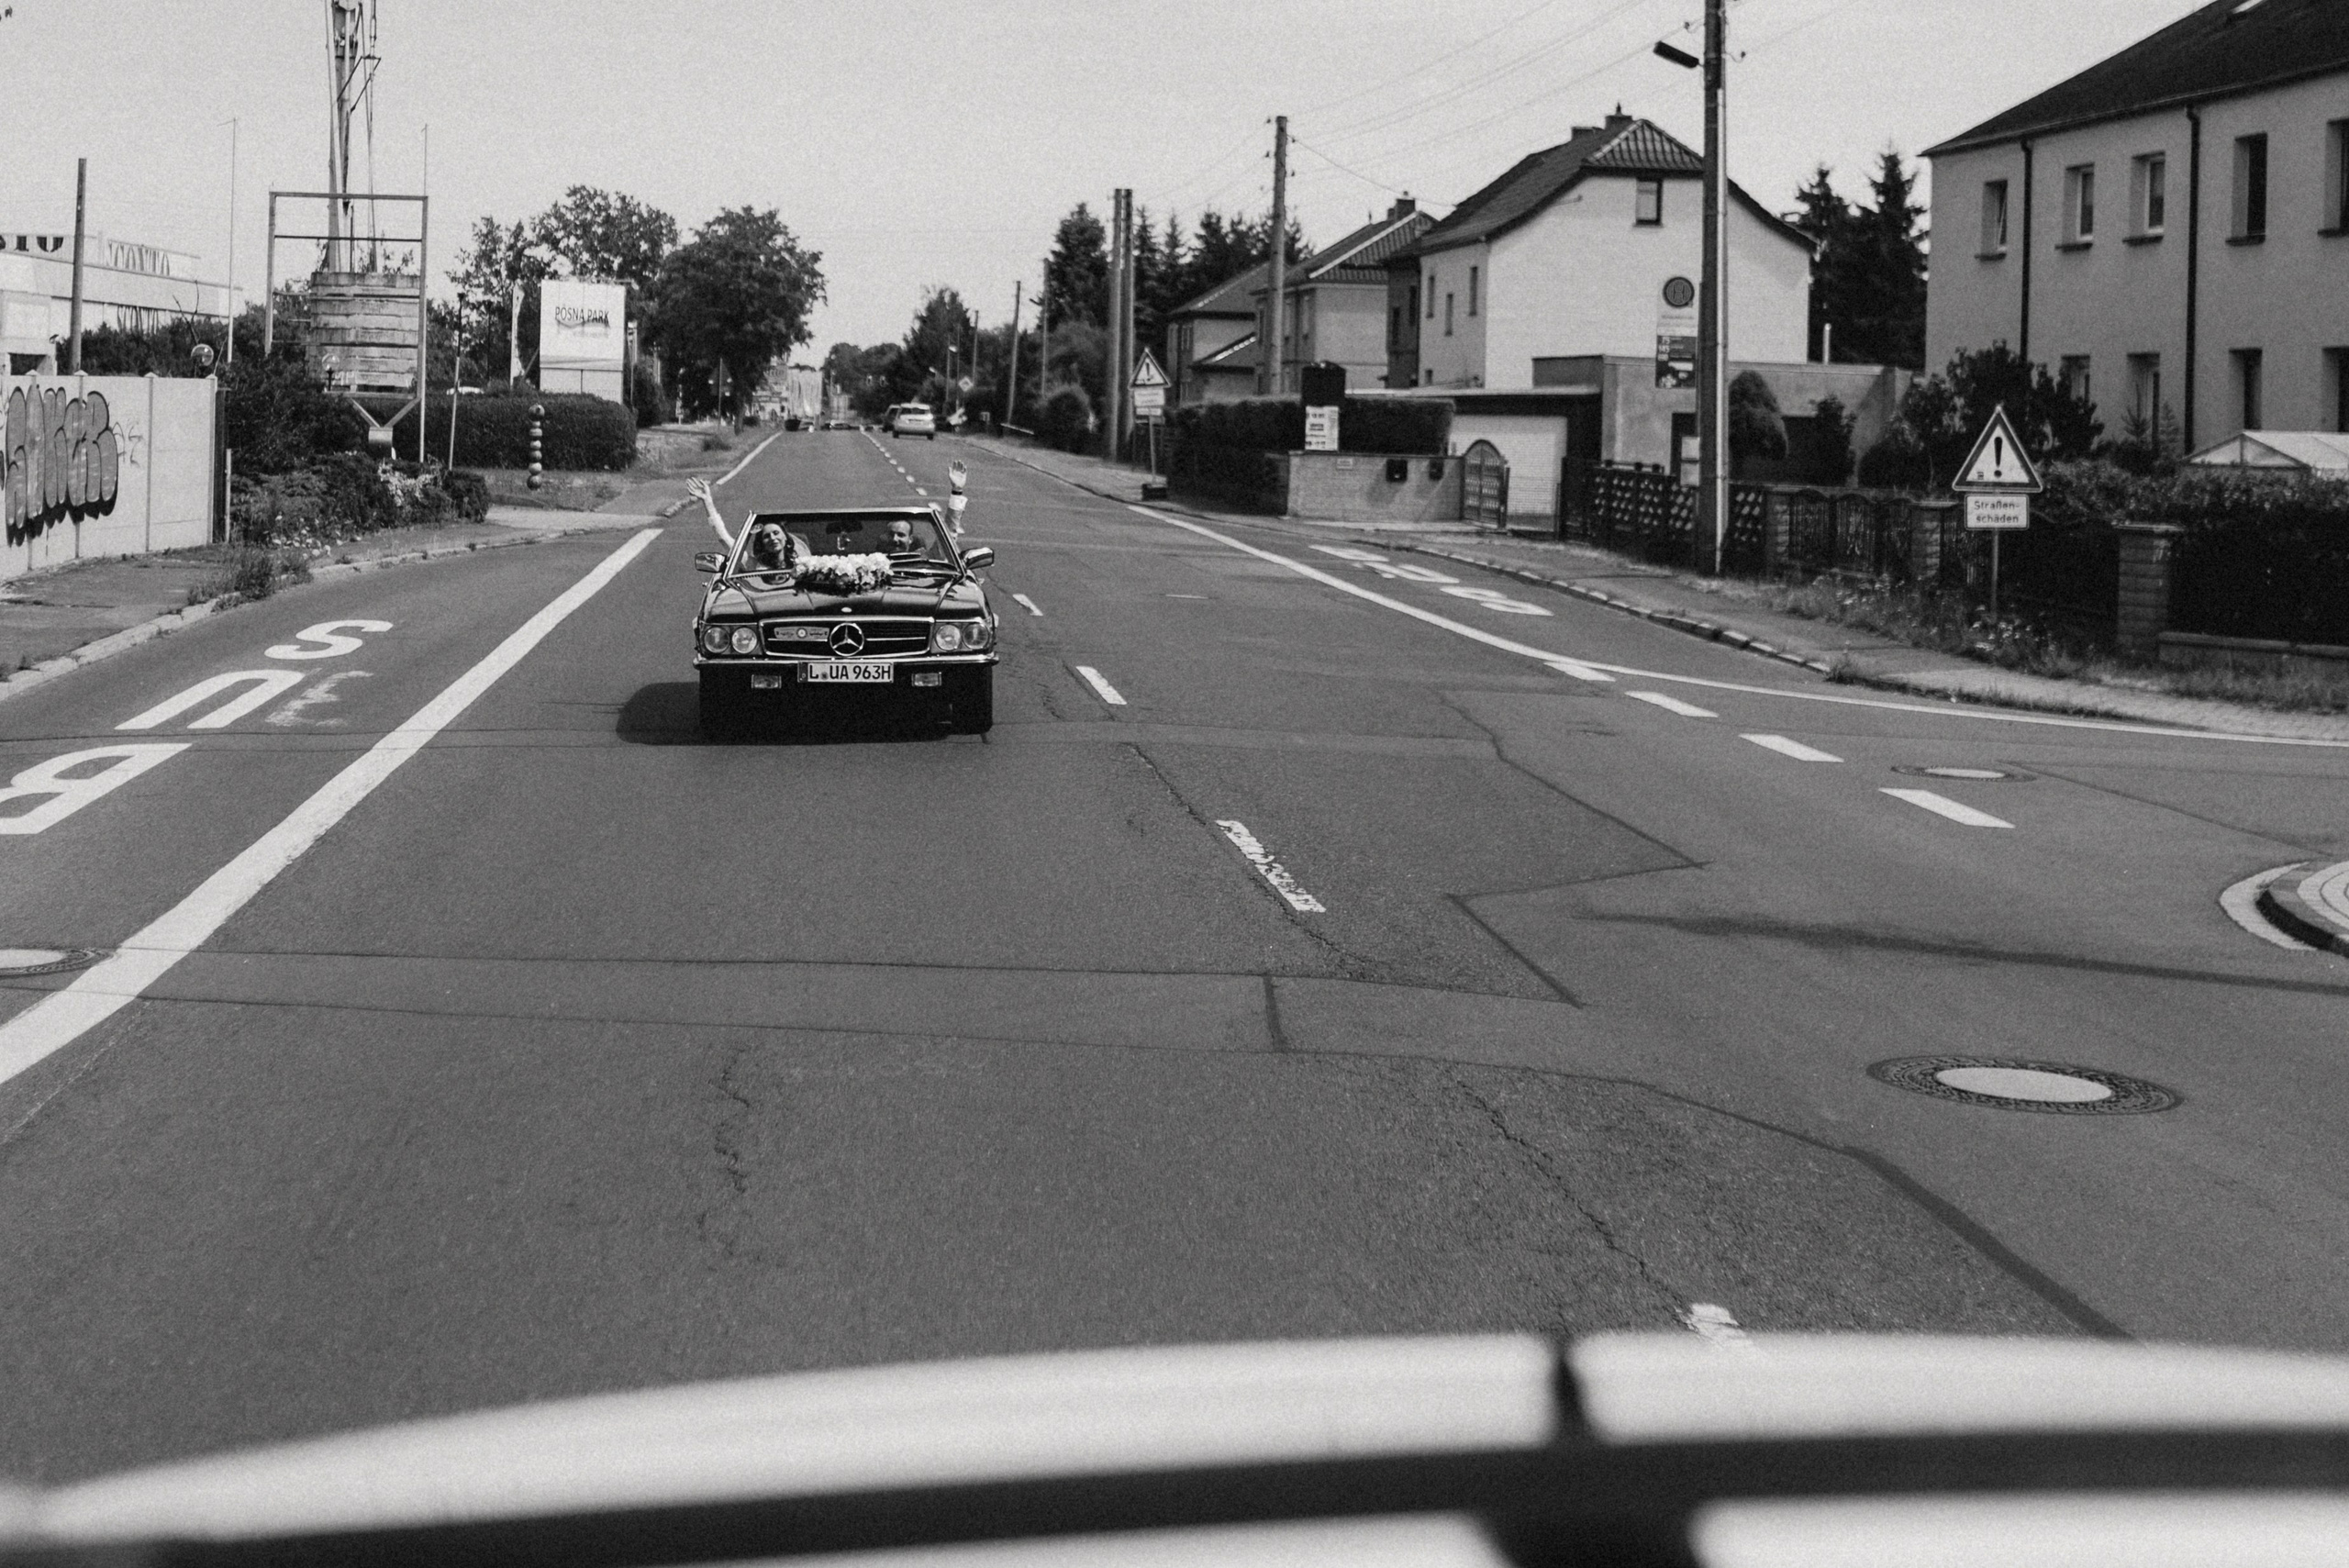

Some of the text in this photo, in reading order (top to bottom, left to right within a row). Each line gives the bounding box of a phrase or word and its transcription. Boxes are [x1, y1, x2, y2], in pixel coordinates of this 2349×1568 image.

[554, 306, 611, 326] POSNA PARK
[1974, 500, 2020, 510] Straßen-
[1976, 514, 2019, 523] schäden
[809, 664, 891, 681] L UA 963H
